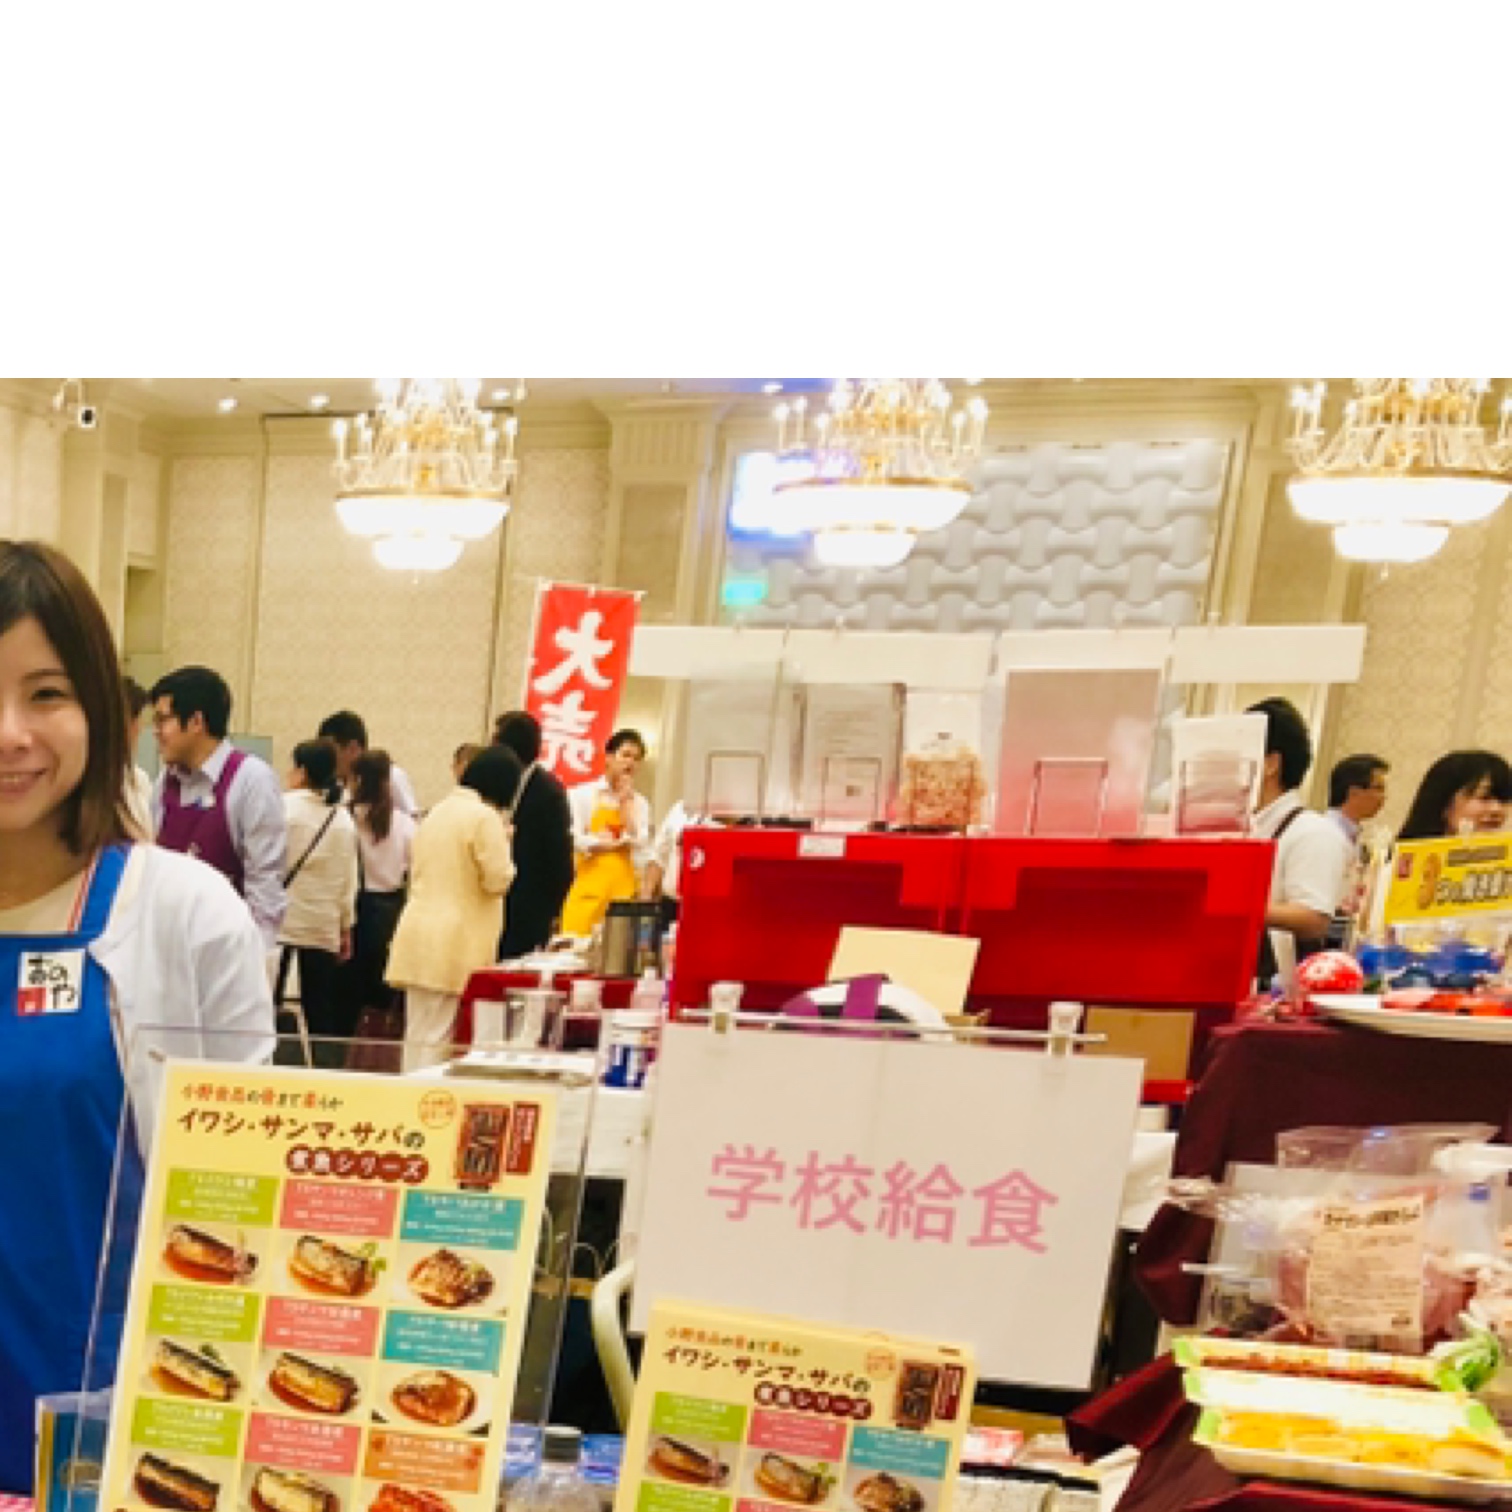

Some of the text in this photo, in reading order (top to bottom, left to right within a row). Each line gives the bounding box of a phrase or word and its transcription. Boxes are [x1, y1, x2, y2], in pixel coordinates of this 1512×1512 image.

[177, 1107, 426, 1150] イワシ・サンマ・サバの
[289, 1147, 428, 1182] 煮魚シリーズ
[707, 1143, 1059, 1255] 学校給食
